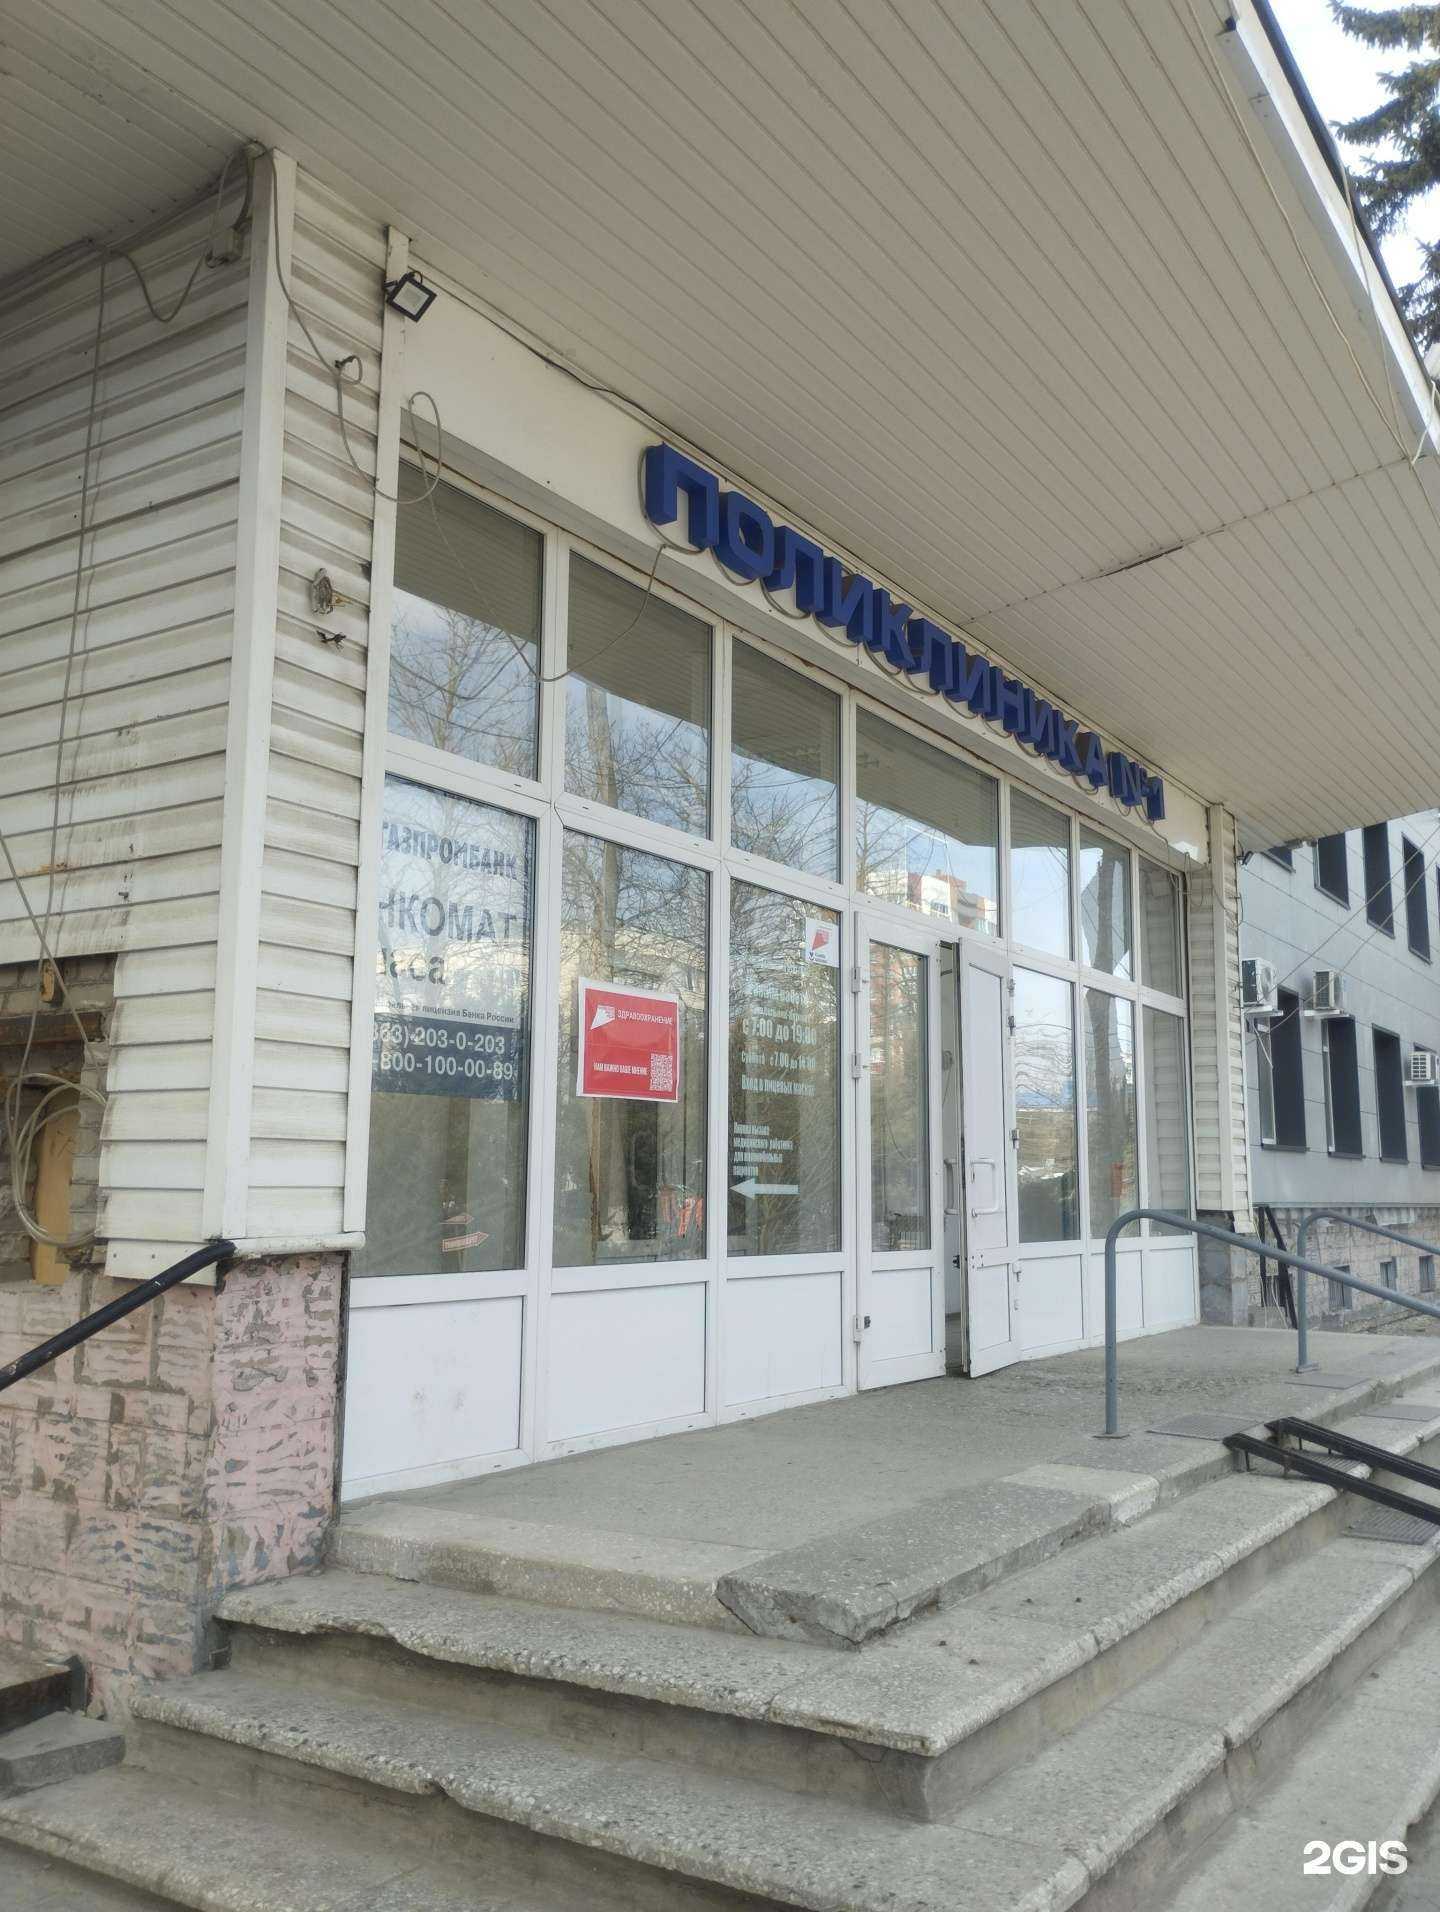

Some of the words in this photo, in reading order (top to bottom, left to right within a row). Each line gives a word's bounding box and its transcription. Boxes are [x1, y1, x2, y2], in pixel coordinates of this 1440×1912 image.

[645, 443, 1108, 787] ПОЛИКЛИНИКА
[1108, 751, 1165, 821] №1
[382, 821, 518, 880] АЗПРОМБАНК
[462, 1009, 485, 1021] Банка
[486, 1012, 514, 1024] России
[775, 1024, 789, 1044] до
